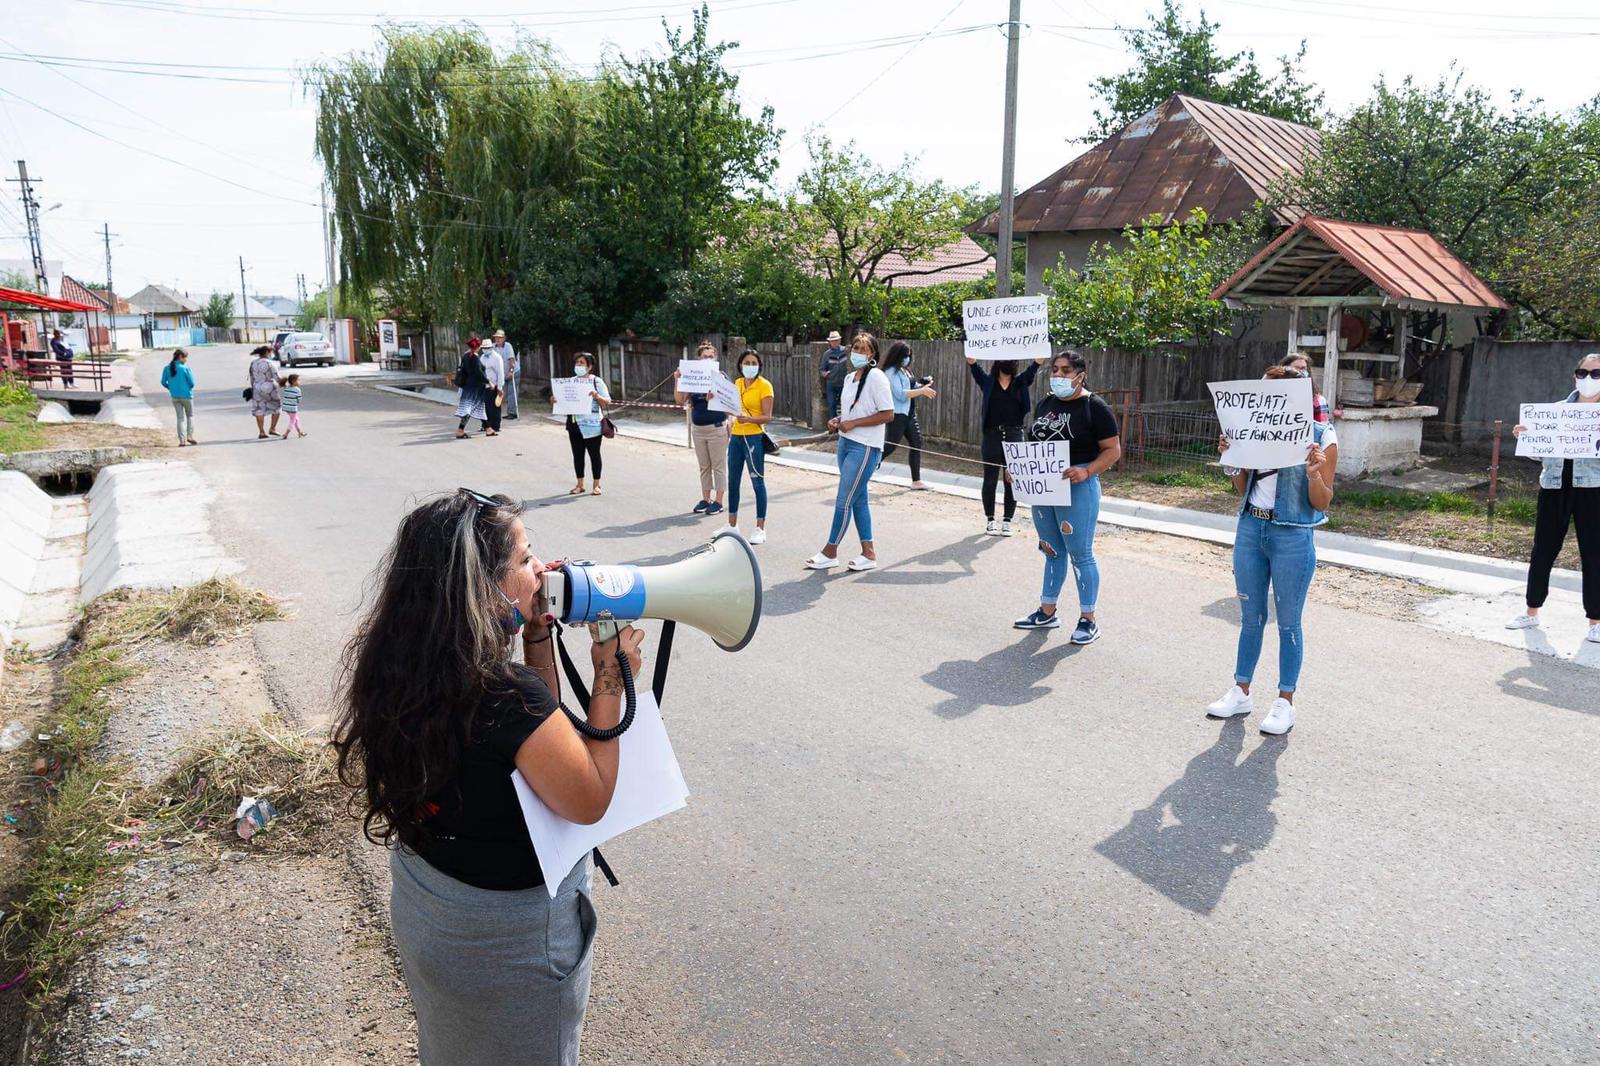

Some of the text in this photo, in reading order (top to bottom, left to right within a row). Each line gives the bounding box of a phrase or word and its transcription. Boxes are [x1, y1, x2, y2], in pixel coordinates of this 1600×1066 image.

[967, 305, 991, 318] UNDE
[995, 305, 1001, 315] E
[968, 323, 989, 332] UNDE
[992, 323, 997, 331] E
[968, 340, 990, 349] UNDE
[1522, 405, 1558, 419] PENTRU
[1533, 422, 1560, 431] DOAR
[1520, 433, 1552, 444] PENTRU
[1009, 459, 1065, 475] COMPLICE
[1022, 478, 1054, 495] VIOL
